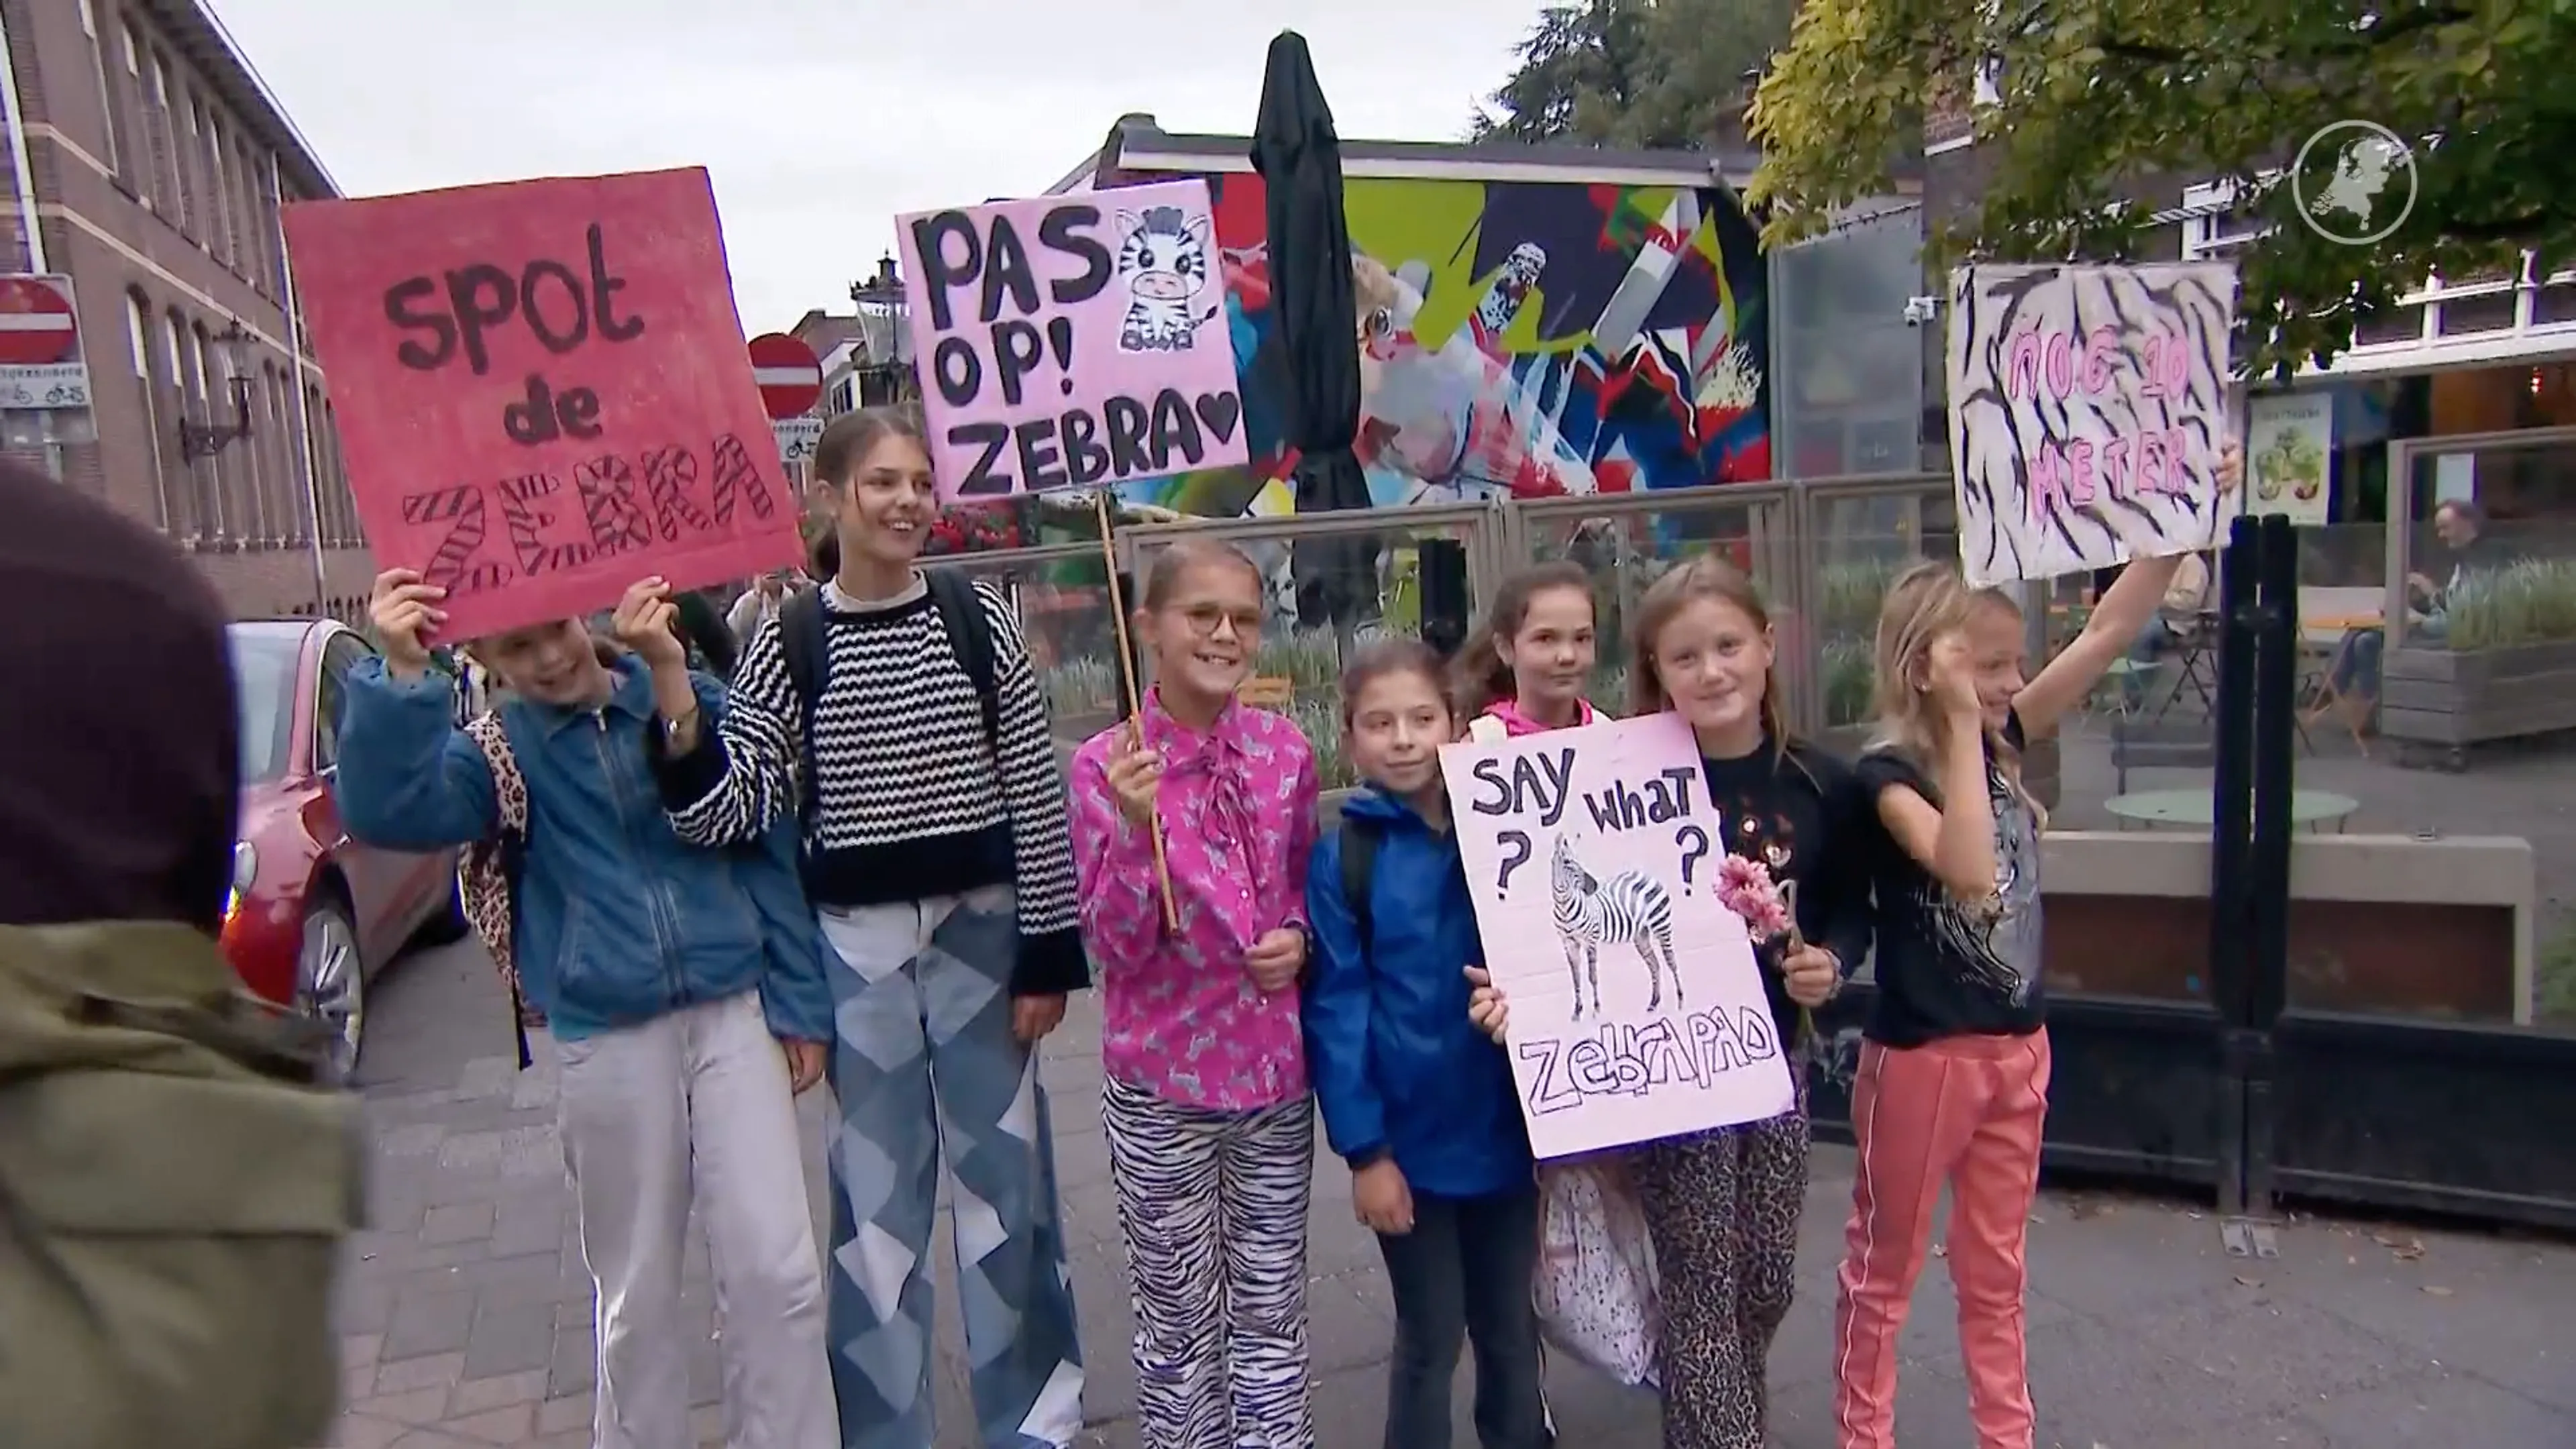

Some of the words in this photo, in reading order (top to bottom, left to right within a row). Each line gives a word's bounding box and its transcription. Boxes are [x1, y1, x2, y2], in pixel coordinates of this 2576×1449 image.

[912, 205, 1113, 331] PAS
[934, 316, 1073, 407] OP!
[2009, 324, 2118, 400] NOG
[2141, 333, 2190, 402] 10
[503, 374, 602, 445] de
[947, 388, 1204, 496] ZEBRA
[402, 433, 775, 596] ZEBRA
[2029, 424, 2188, 525] METER
[1472, 748, 1575, 826] SAY
[1497, 830, 1532, 900] ?
[1675, 826, 1709, 896] ?
